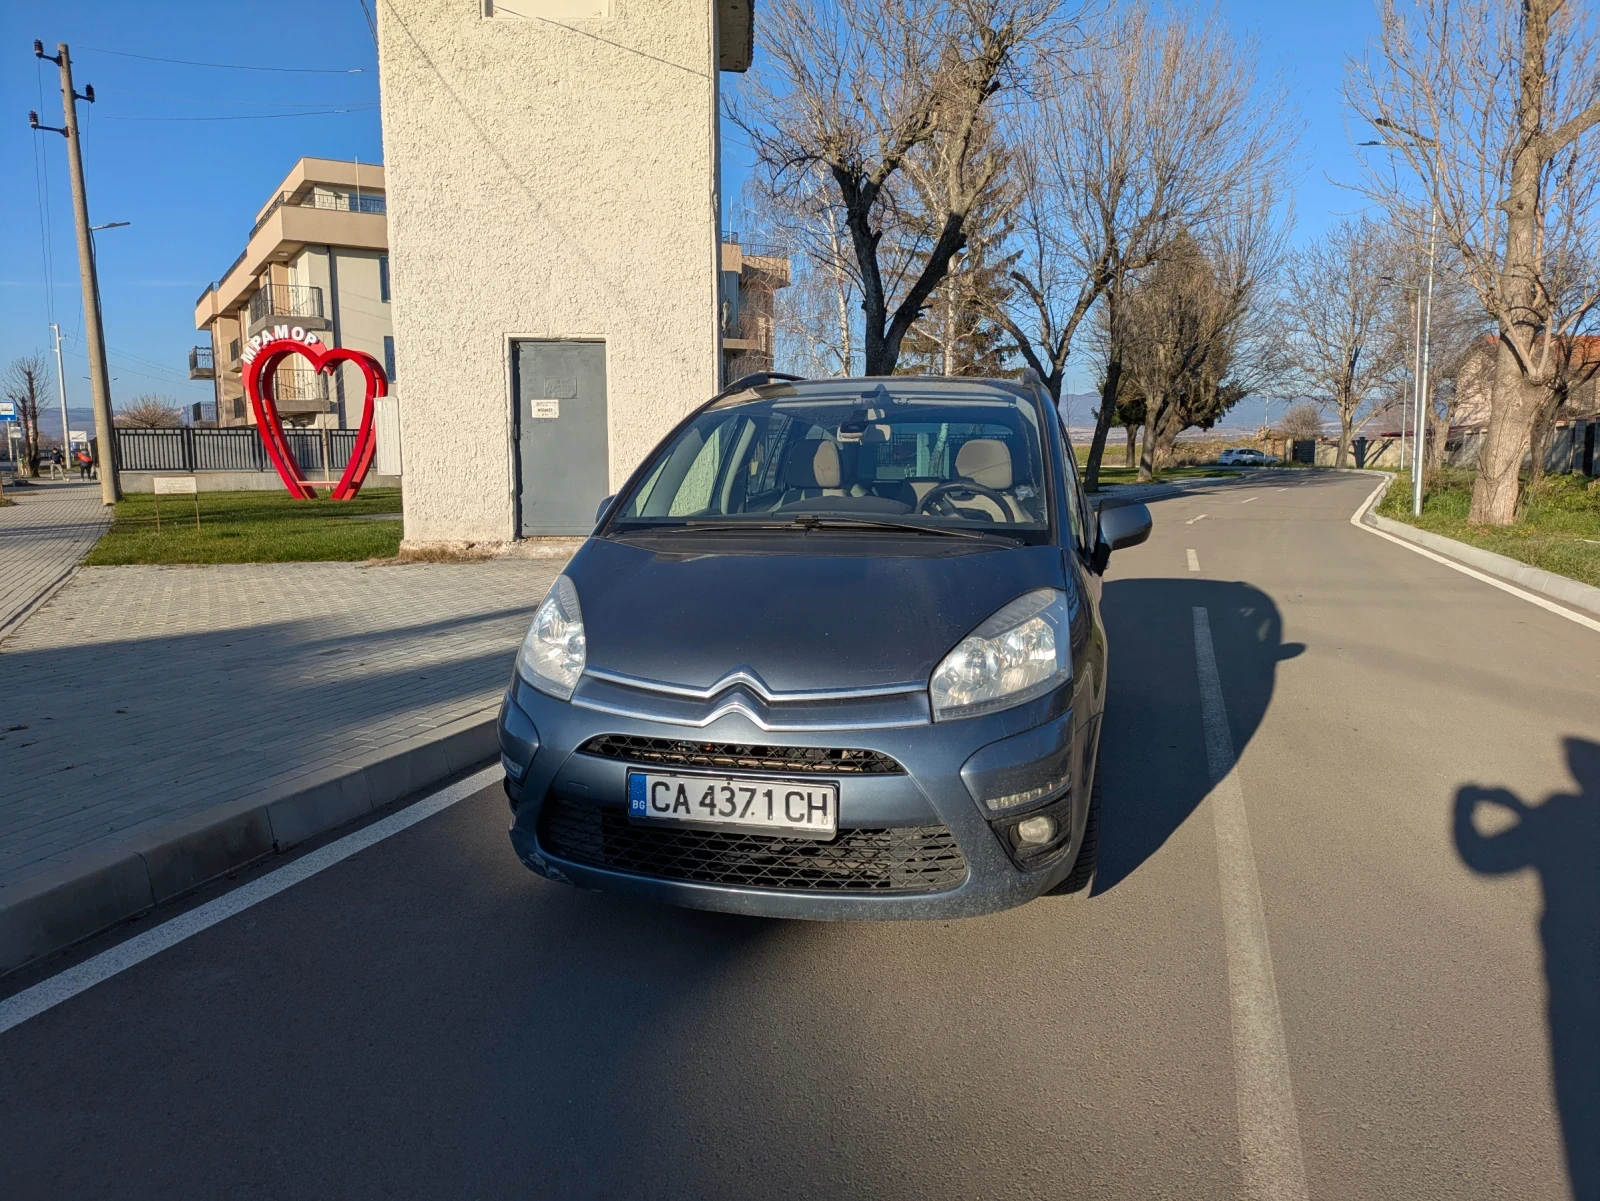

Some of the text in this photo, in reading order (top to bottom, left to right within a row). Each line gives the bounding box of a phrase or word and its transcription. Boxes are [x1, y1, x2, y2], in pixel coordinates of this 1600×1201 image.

[240, 324, 318, 364] МРАМОР
[632, 799, 646, 810] BG
[651, 780, 828, 826] CA 4371 CH
